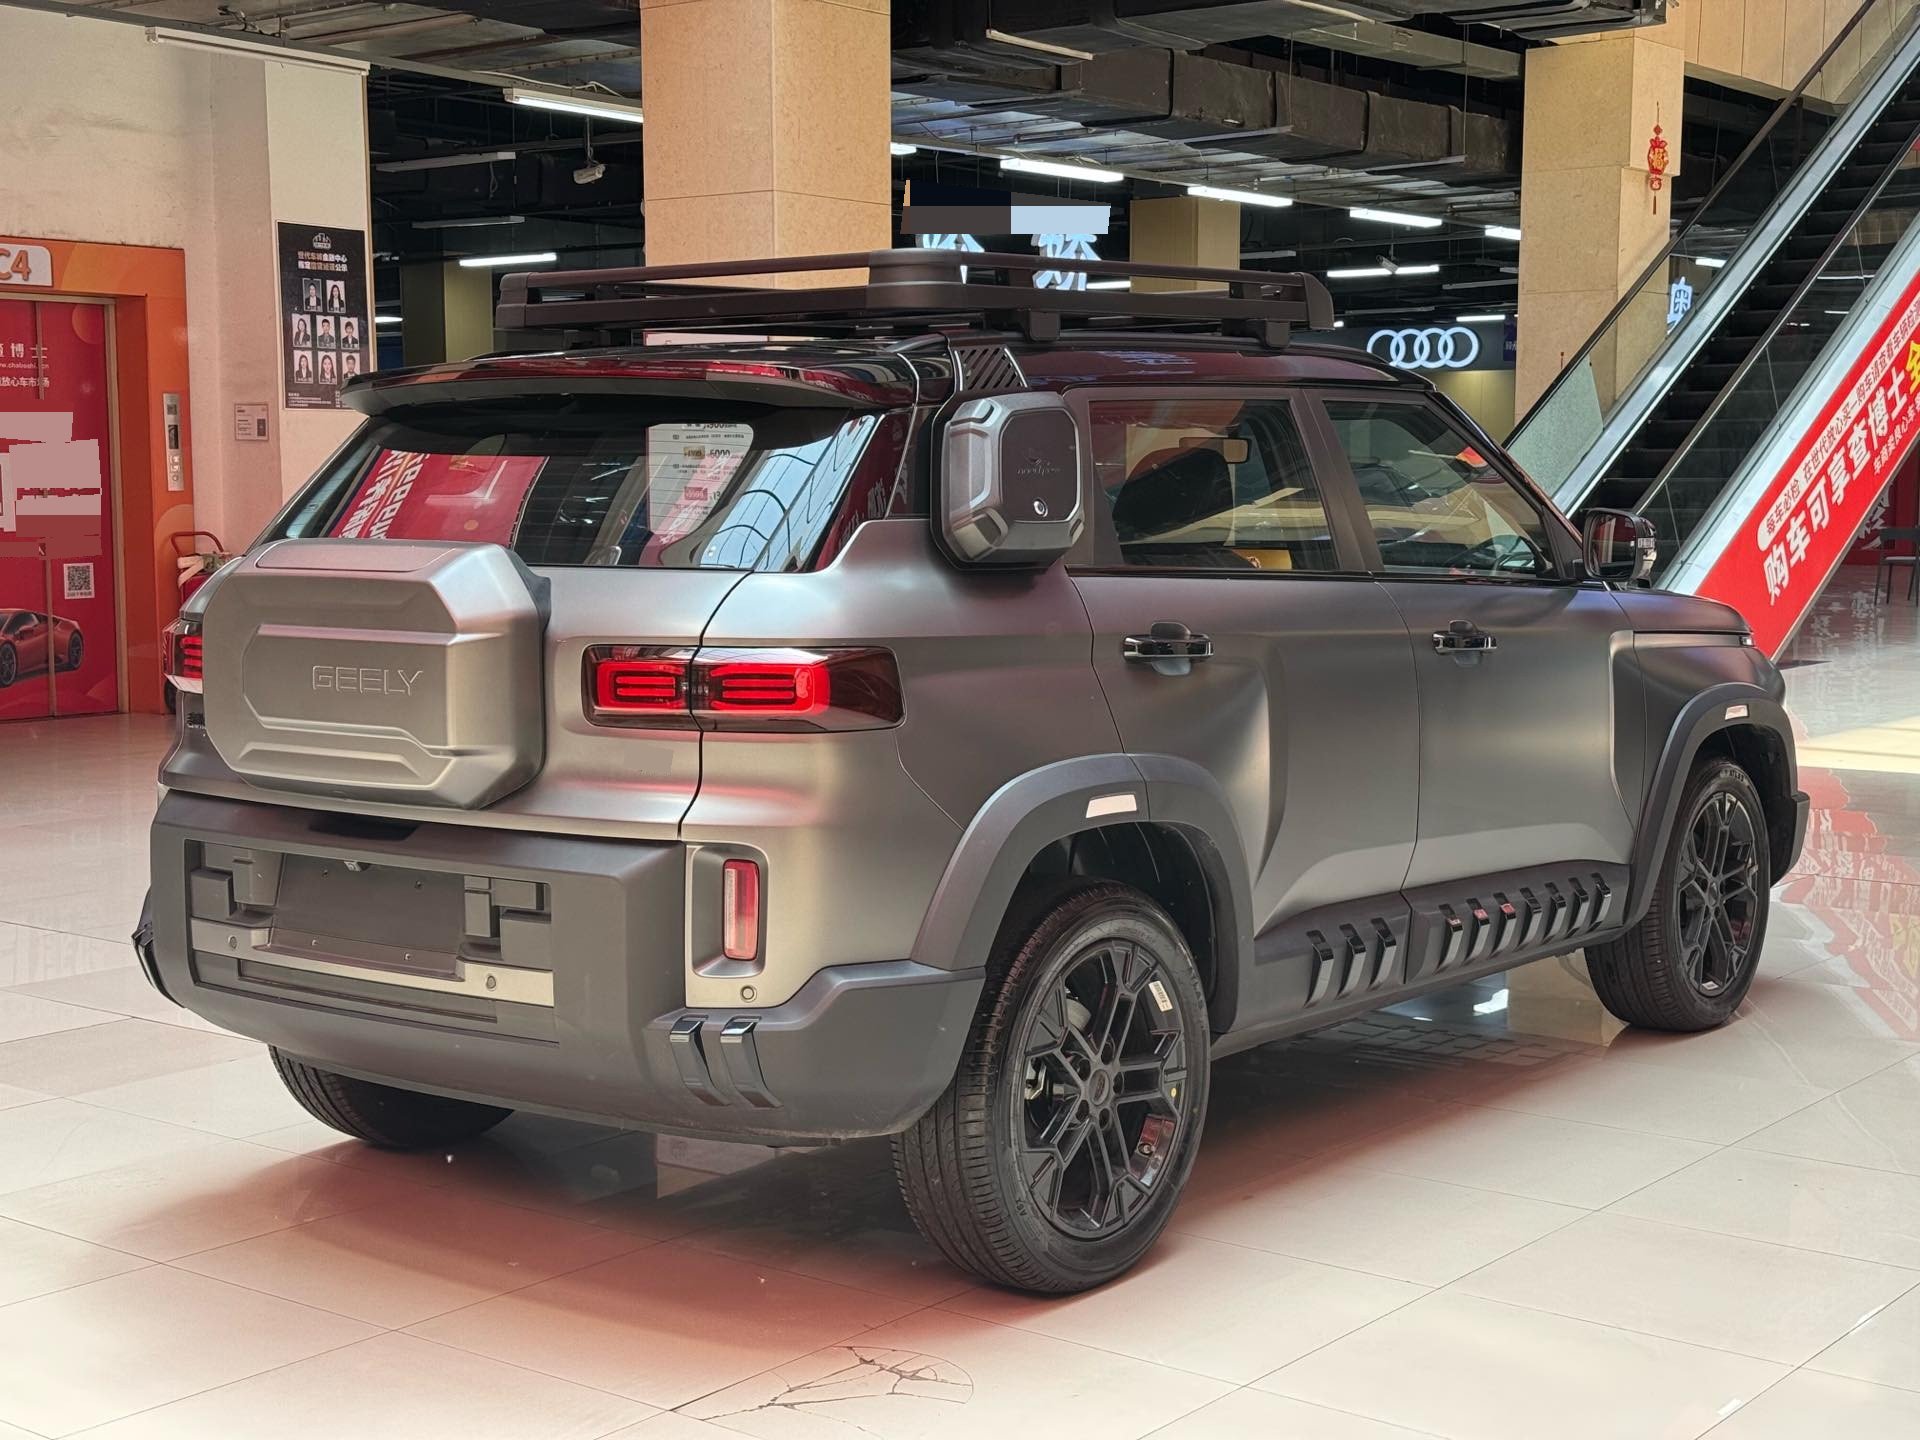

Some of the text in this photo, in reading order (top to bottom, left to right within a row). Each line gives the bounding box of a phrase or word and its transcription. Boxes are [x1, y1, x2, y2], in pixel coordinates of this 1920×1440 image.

[0, 377, 49, 388] 放心车市场
[312, 665, 424, 696] GEELY
